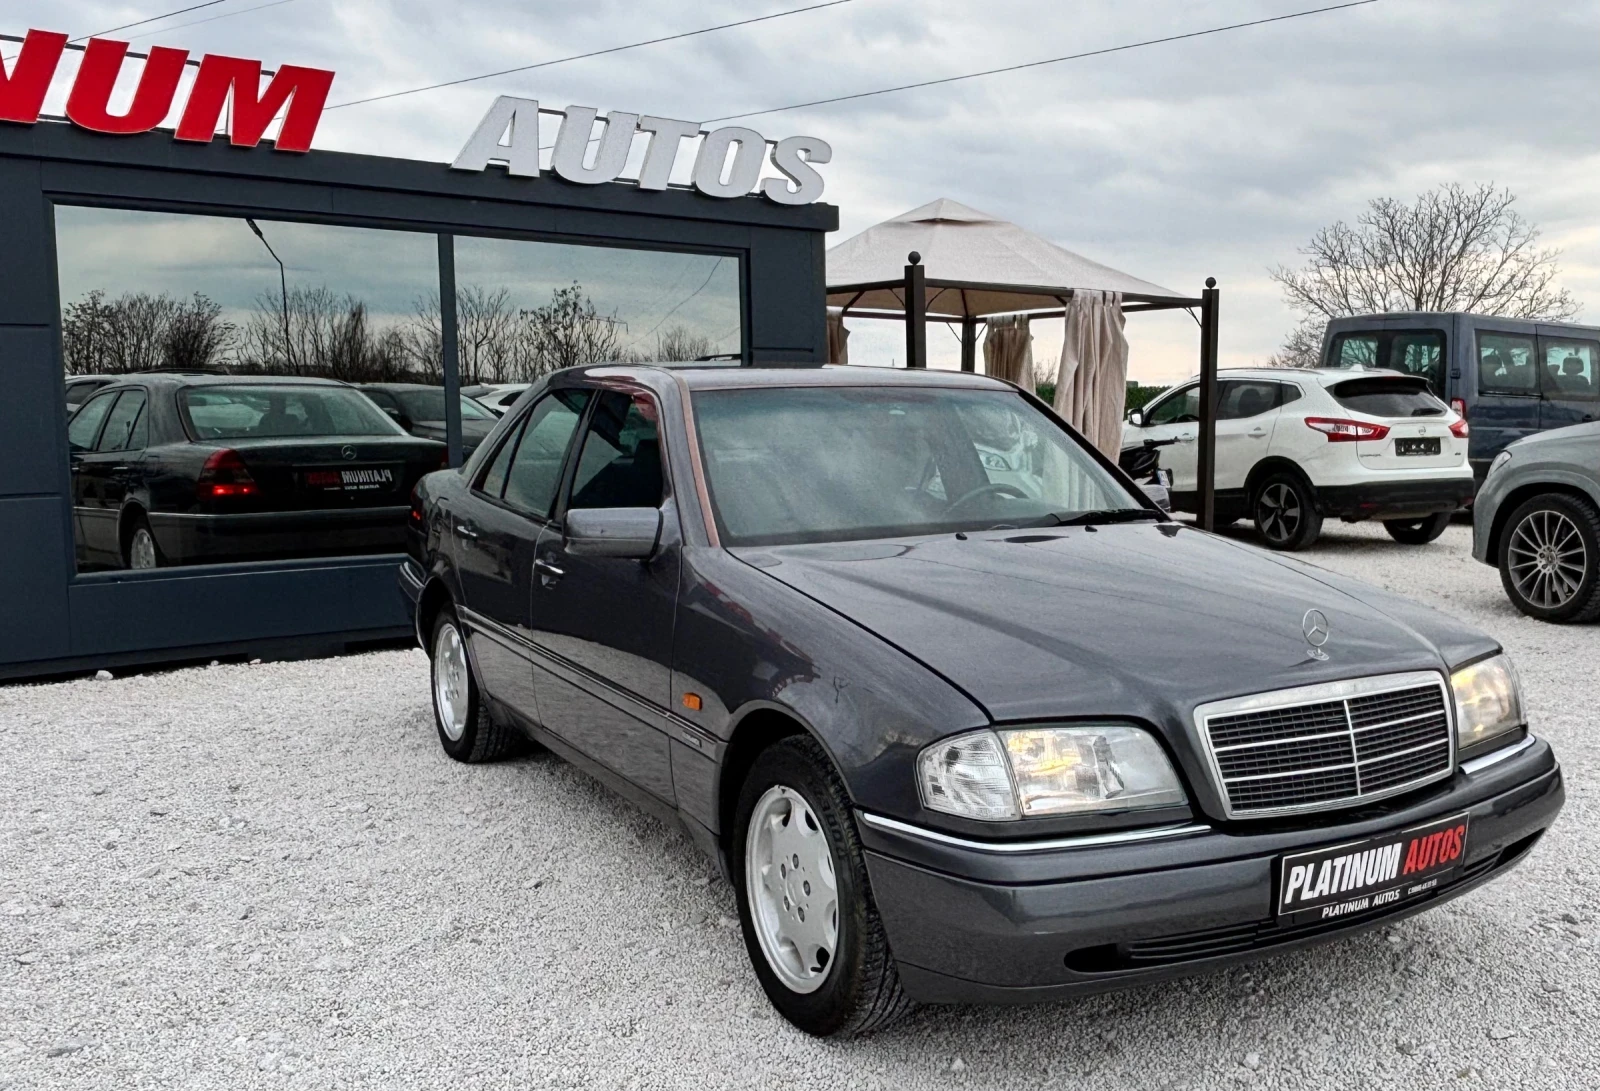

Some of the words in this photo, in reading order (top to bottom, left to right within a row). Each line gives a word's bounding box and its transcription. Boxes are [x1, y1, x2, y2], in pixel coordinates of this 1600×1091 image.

[450, 95, 833, 205] AUTOS
[1284, 842, 1403, 905] PLATINUM
[1402, 825, 1465, 875] AUTOS
[1321, 897, 1369, 919] PLATINUM
[1372, 889, 1401, 907] AUTOS
